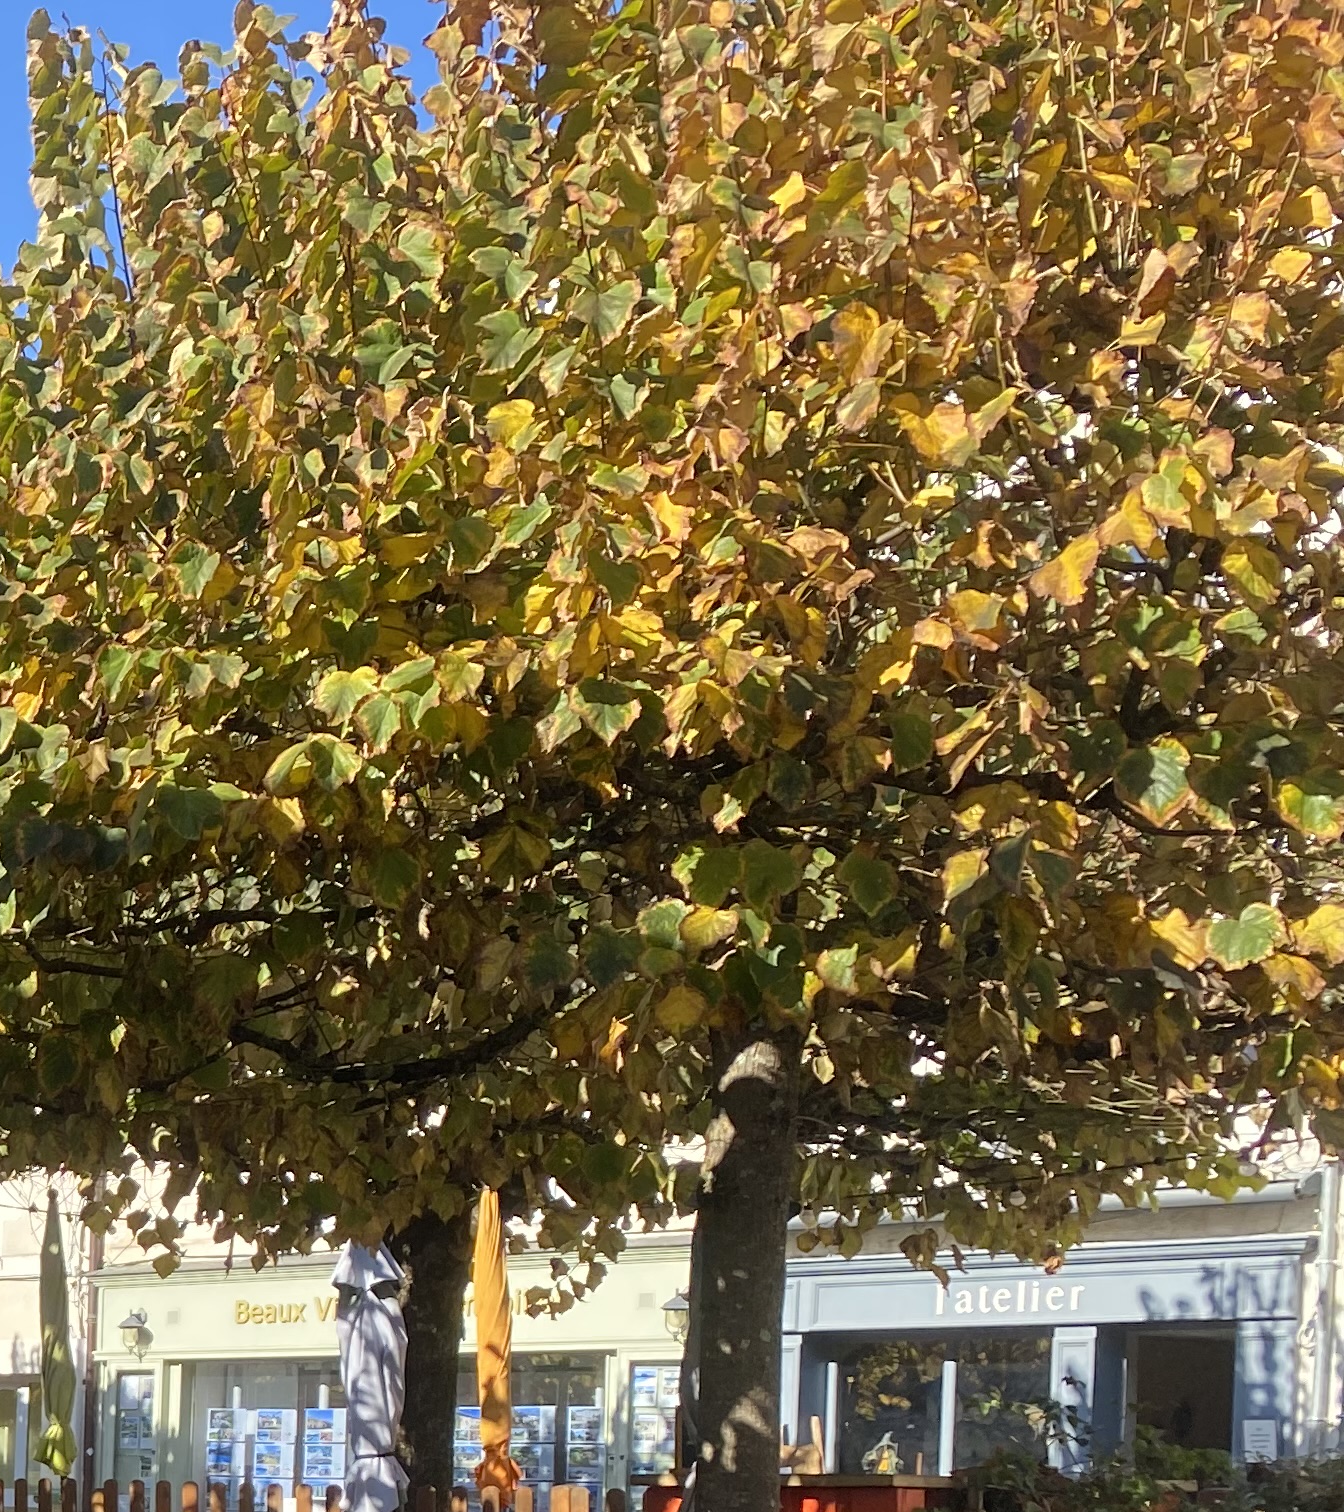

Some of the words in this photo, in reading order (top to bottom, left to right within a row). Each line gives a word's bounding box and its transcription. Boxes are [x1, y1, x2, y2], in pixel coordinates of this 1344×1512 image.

[234, 1298, 307, 1326] Beaux
[313, 1296, 339, 1324] Vi
[935, 1280, 1086, 1316] latelier
